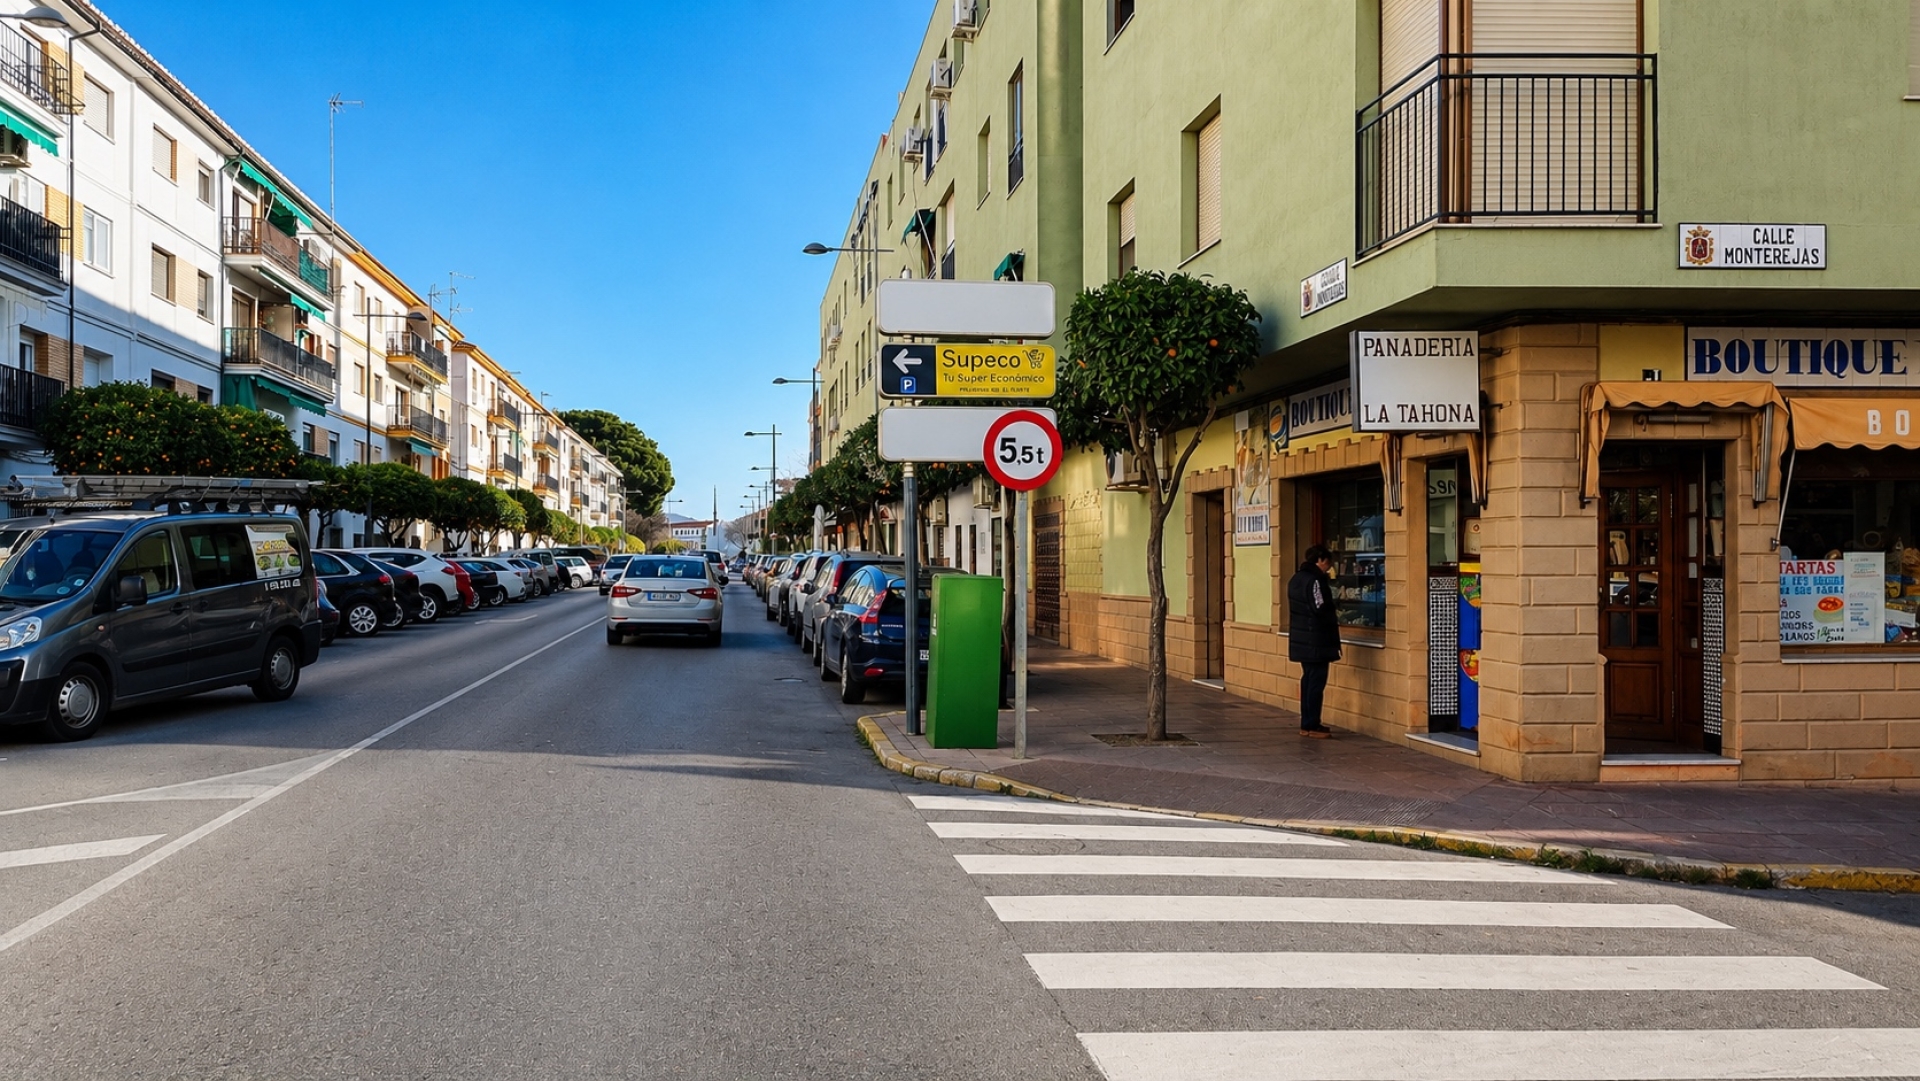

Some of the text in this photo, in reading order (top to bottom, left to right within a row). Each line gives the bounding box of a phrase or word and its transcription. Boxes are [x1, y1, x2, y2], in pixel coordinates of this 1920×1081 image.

[1753, 228, 1795, 245] CALLE
[1724, 247, 1820, 265] MONTEREJAS
[1363, 338, 1475, 357] PANADERIA
[942, 349, 1021, 372] Supeco
[1692, 338, 1908, 379] BOUTIQUE
[904, 379, 913, 391] P
[943, 373, 1045, 384] Tu Super Económico
[1364, 404, 1476, 423] LA TAHONA
[1867, 409, 1910, 436] BO
[1779, 562, 1836, 574] TARTAS
